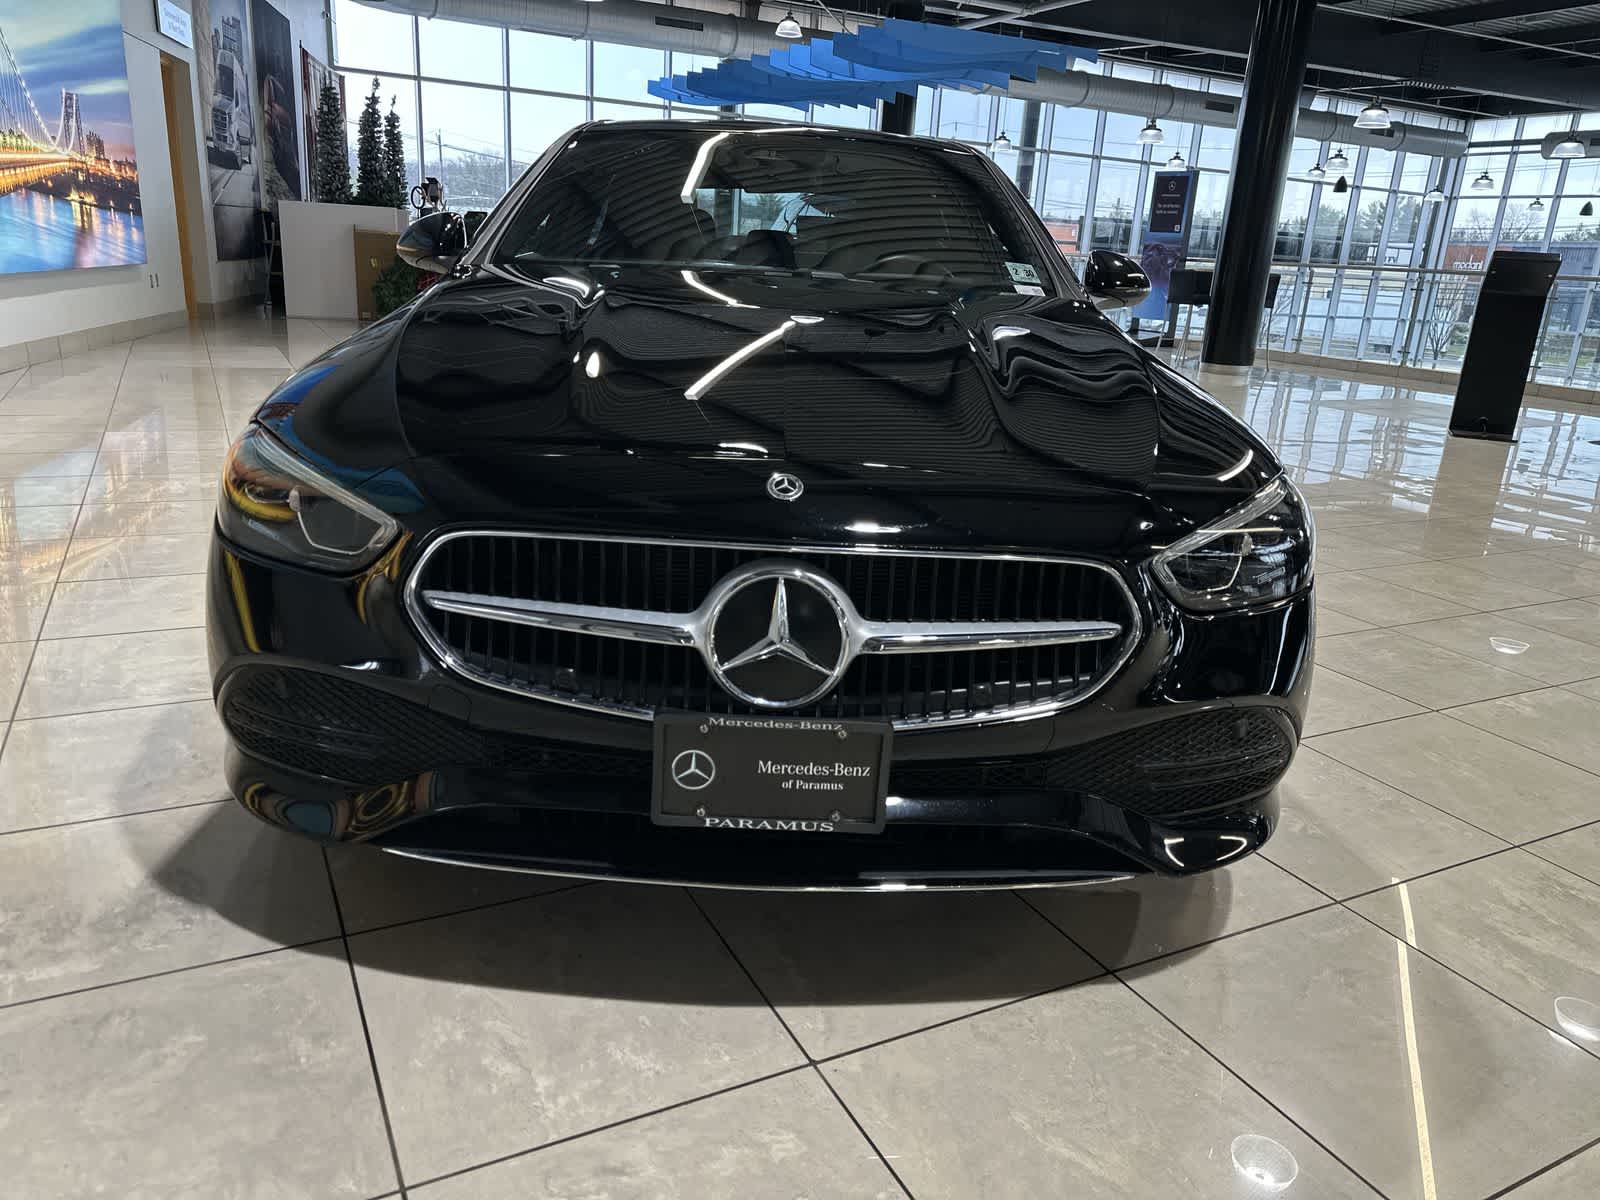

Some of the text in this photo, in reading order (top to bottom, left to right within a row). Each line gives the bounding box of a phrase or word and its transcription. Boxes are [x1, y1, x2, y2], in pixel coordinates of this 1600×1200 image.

[709, 717, 843, 731] Mercedes-Benz
[758, 760, 871, 777] Mercedes-Benz
[781, 779, 844, 791] of Paramus
[703, 817, 835, 832] PARAMUS
